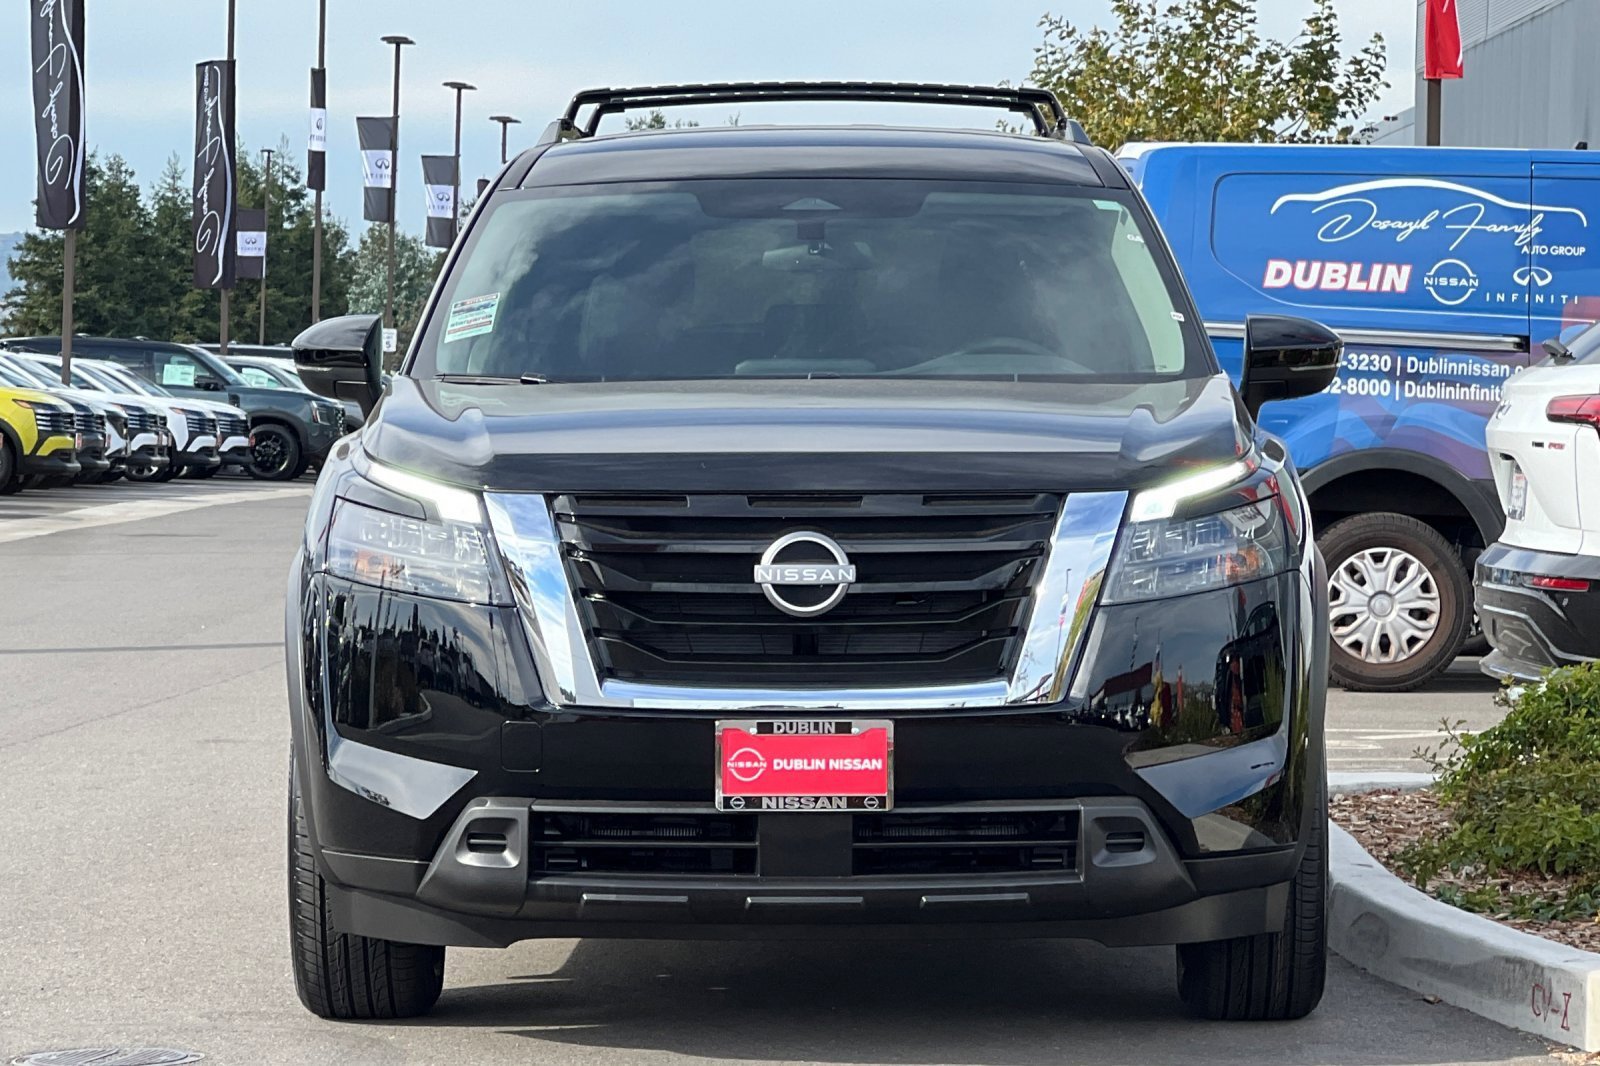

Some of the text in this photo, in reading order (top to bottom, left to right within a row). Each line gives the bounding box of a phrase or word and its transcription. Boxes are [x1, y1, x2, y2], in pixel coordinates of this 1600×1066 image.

[1312, 198, 1544, 251] Dosanjh Family
[1521, 245, 1586, 256] AUTO GROUP
[1263, 259, 1412, 292] DUBLIN
[1423, 276, 1479, 287] NISSAN
[1486, 292, 1578, 305] INFINITI
[1404, 380, 1503, 402] Dublininfinit
[757, 568, 853, 581] NISSAN
[773, 721, 836, 734] DUBLIN
[726, 760, 767, 769] NISSAN
[773, 758, 883, 771] DUBLIN NISSAN
[762, 796, 847, 809] NISSAN
